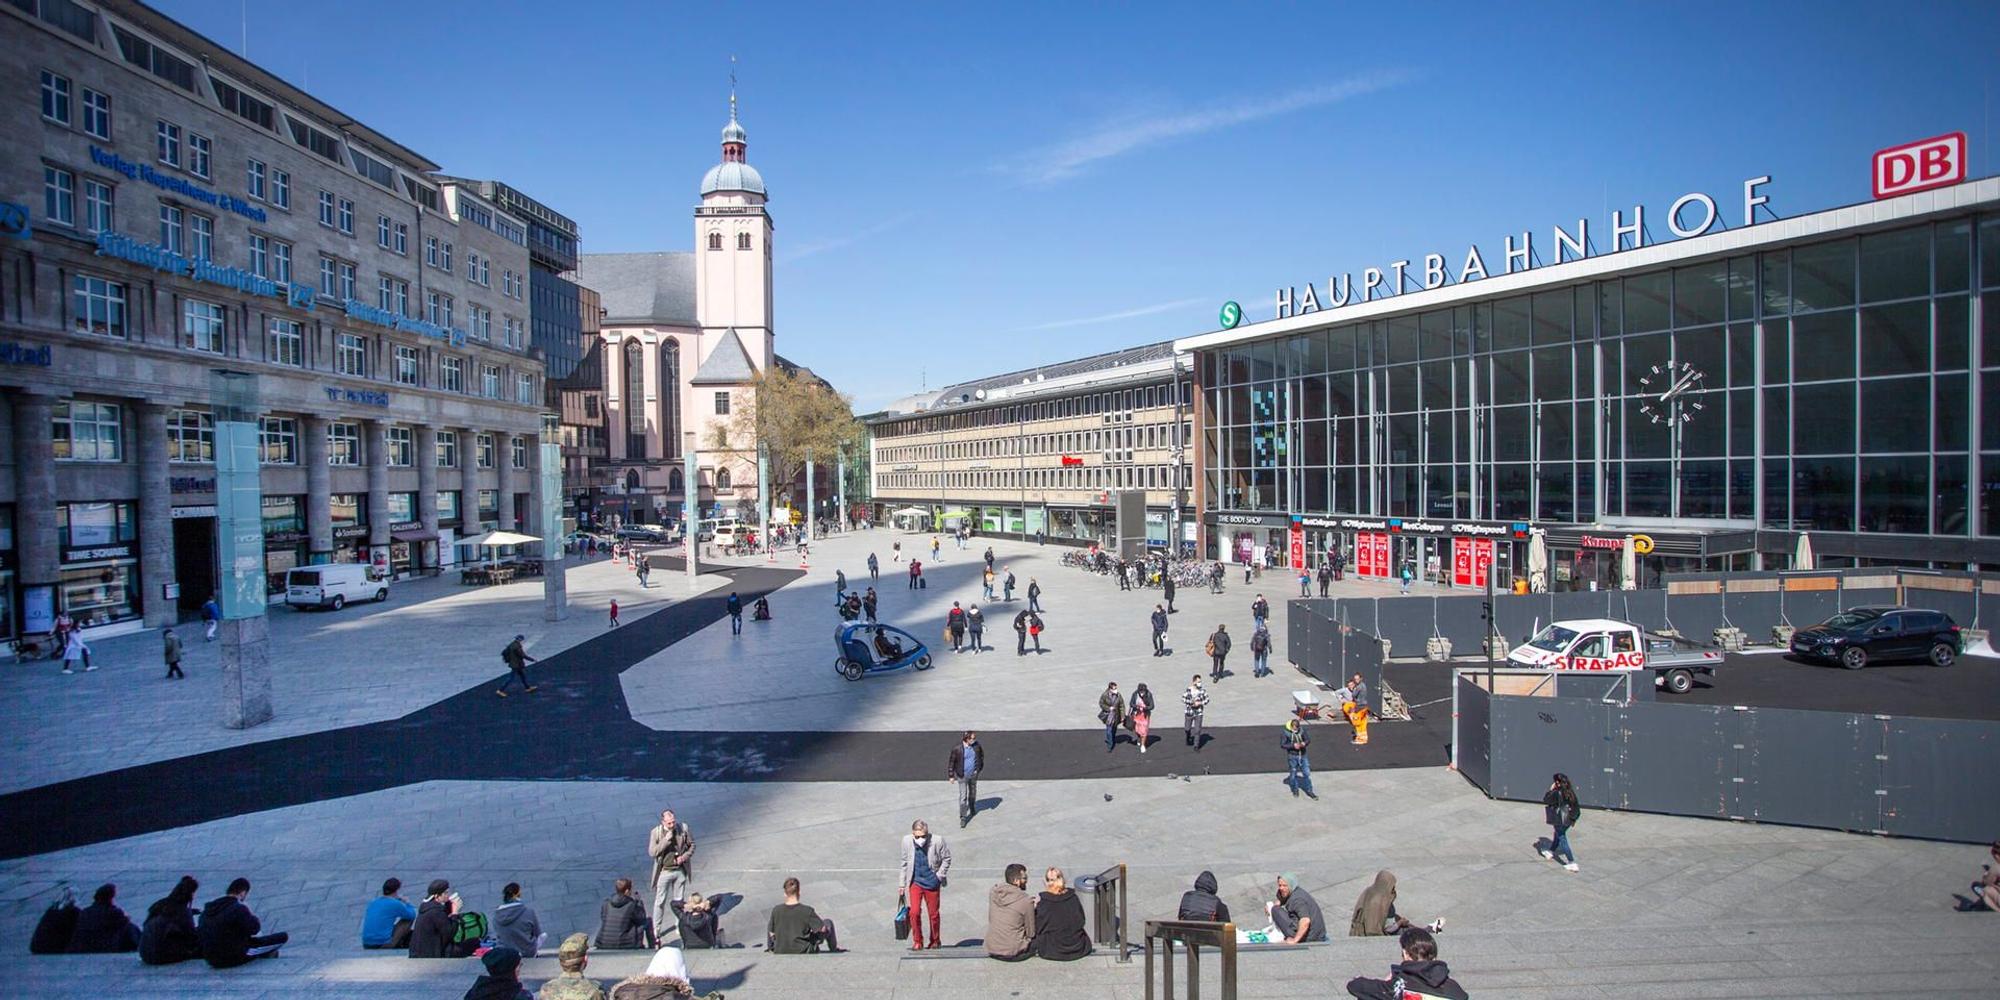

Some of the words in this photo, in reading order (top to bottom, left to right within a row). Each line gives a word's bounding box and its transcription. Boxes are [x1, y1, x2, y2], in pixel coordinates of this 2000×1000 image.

[1881, 142, 1955, 191] DB
[1275, 175, 1772, 319] HAUPTBAHNHOF
[1221, 303, 1237, 326] S
[1218, 514, 1229, 523] THE
[1230, 515, 1245, 524] BODY
[1246, 516, 1263, 525] SHOP
[66, 549, 91, 561] TIME
